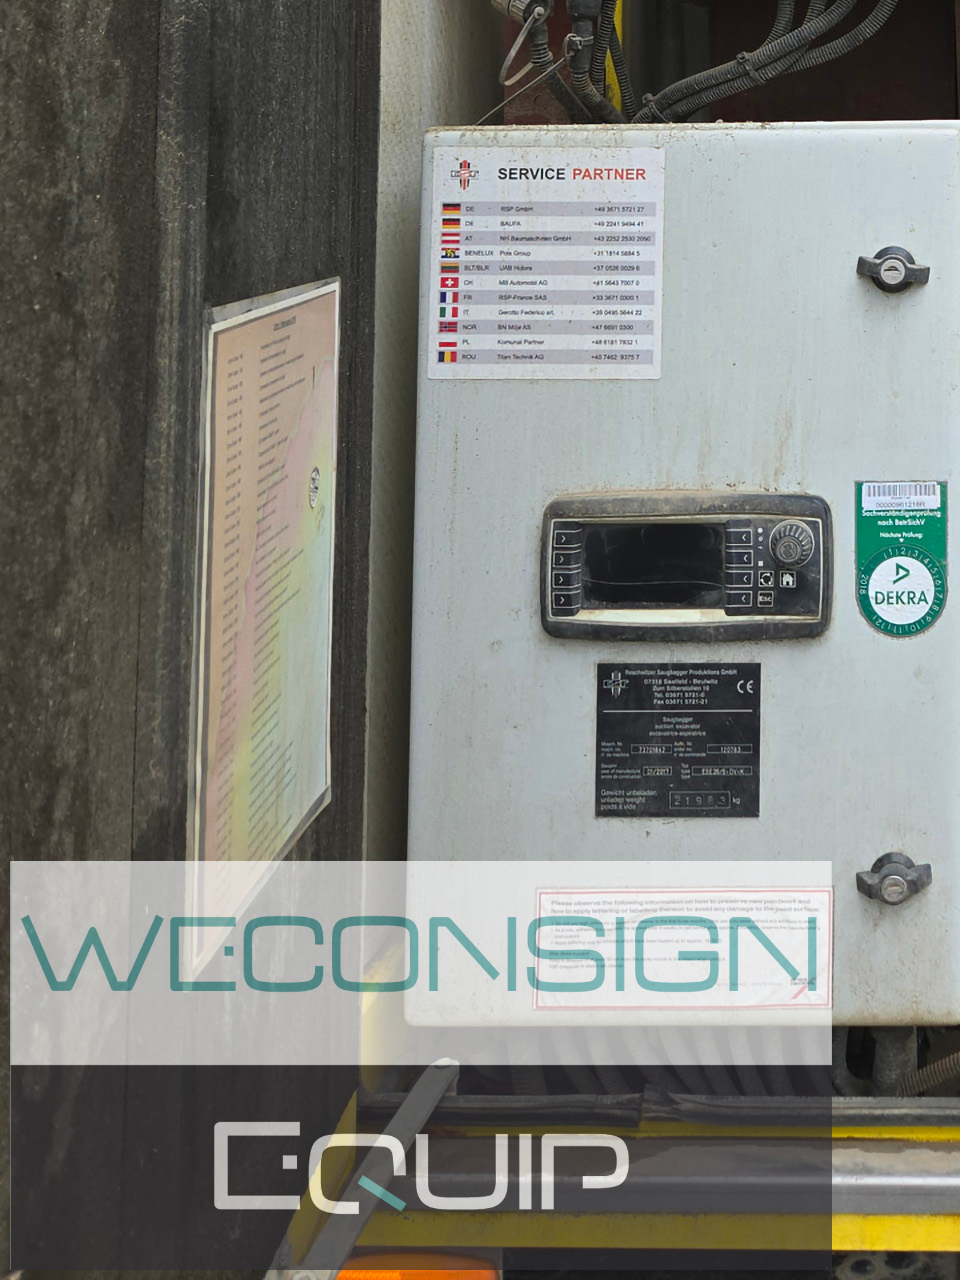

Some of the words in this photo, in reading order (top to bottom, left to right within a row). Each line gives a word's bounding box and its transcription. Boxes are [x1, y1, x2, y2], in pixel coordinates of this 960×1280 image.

[497, 167, 566, 180] SERVICE
[572, 167, 646, 181] PARTNER
[859, 574, 869, 595] 2018
[874, 590, 929, 605] DEKRA
[720, 668, 738, 676] GmbH
[732, 797, 741, 805] kg
